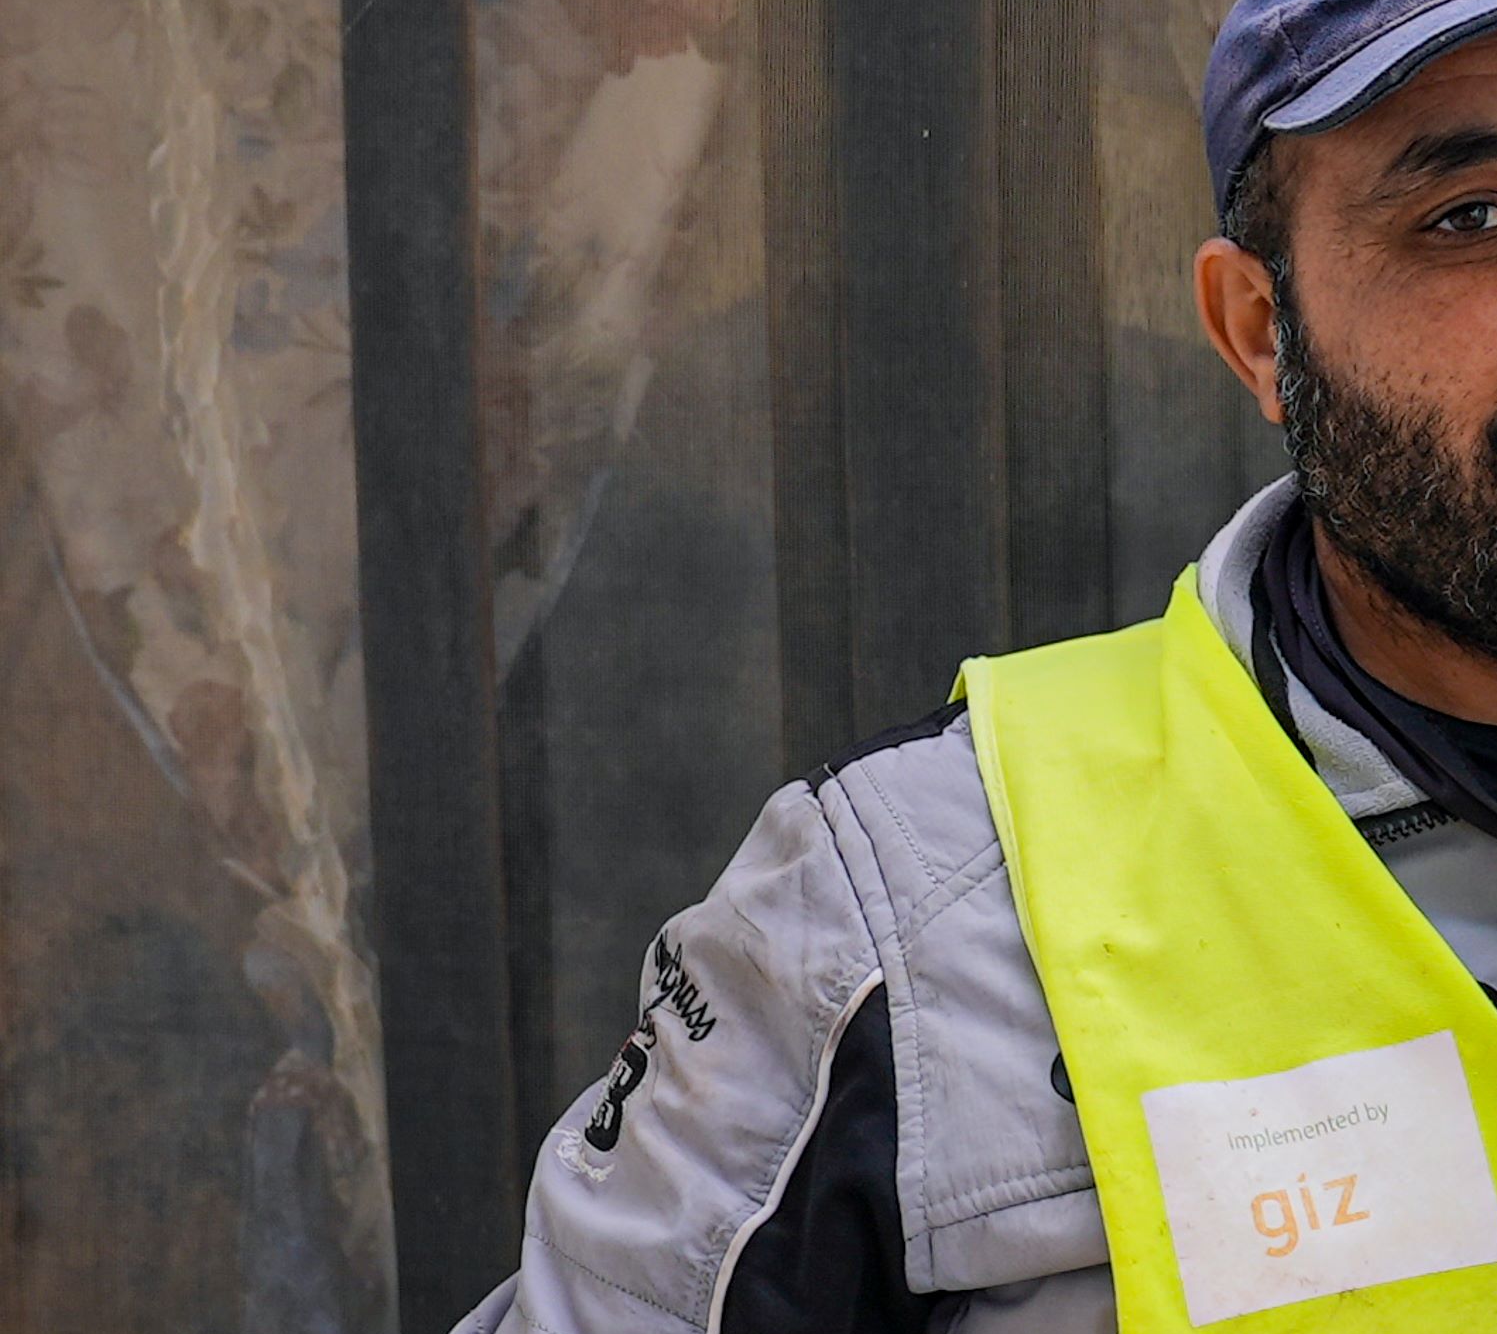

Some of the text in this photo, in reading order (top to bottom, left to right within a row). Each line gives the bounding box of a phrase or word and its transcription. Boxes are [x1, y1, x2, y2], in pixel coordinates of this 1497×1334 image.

[1226, 1102, 1389, 1152] Implemented by
[1250, 1172, 1371, 1259] giz
